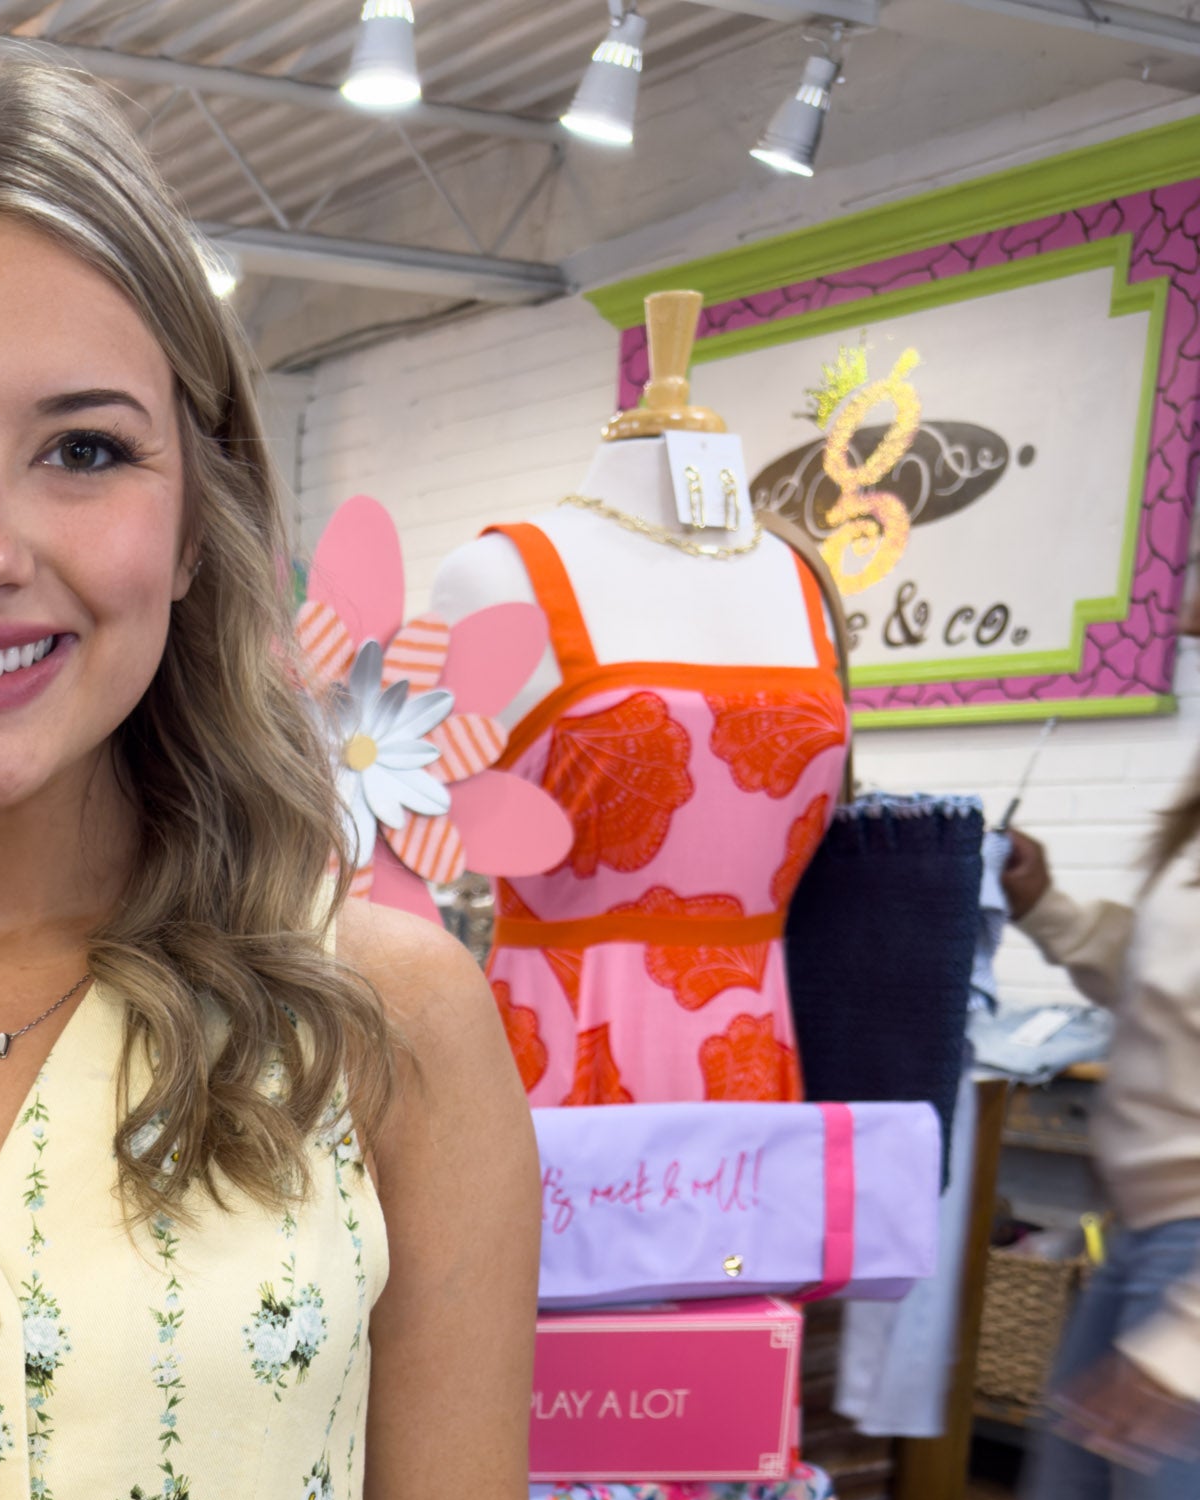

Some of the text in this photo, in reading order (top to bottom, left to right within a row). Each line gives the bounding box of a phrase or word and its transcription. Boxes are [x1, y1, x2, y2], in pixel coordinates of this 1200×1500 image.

[882, 580, 930, 649] &
[598, 1390, 622, 1419] A
[629, 1388, 690, 1419] LOT
